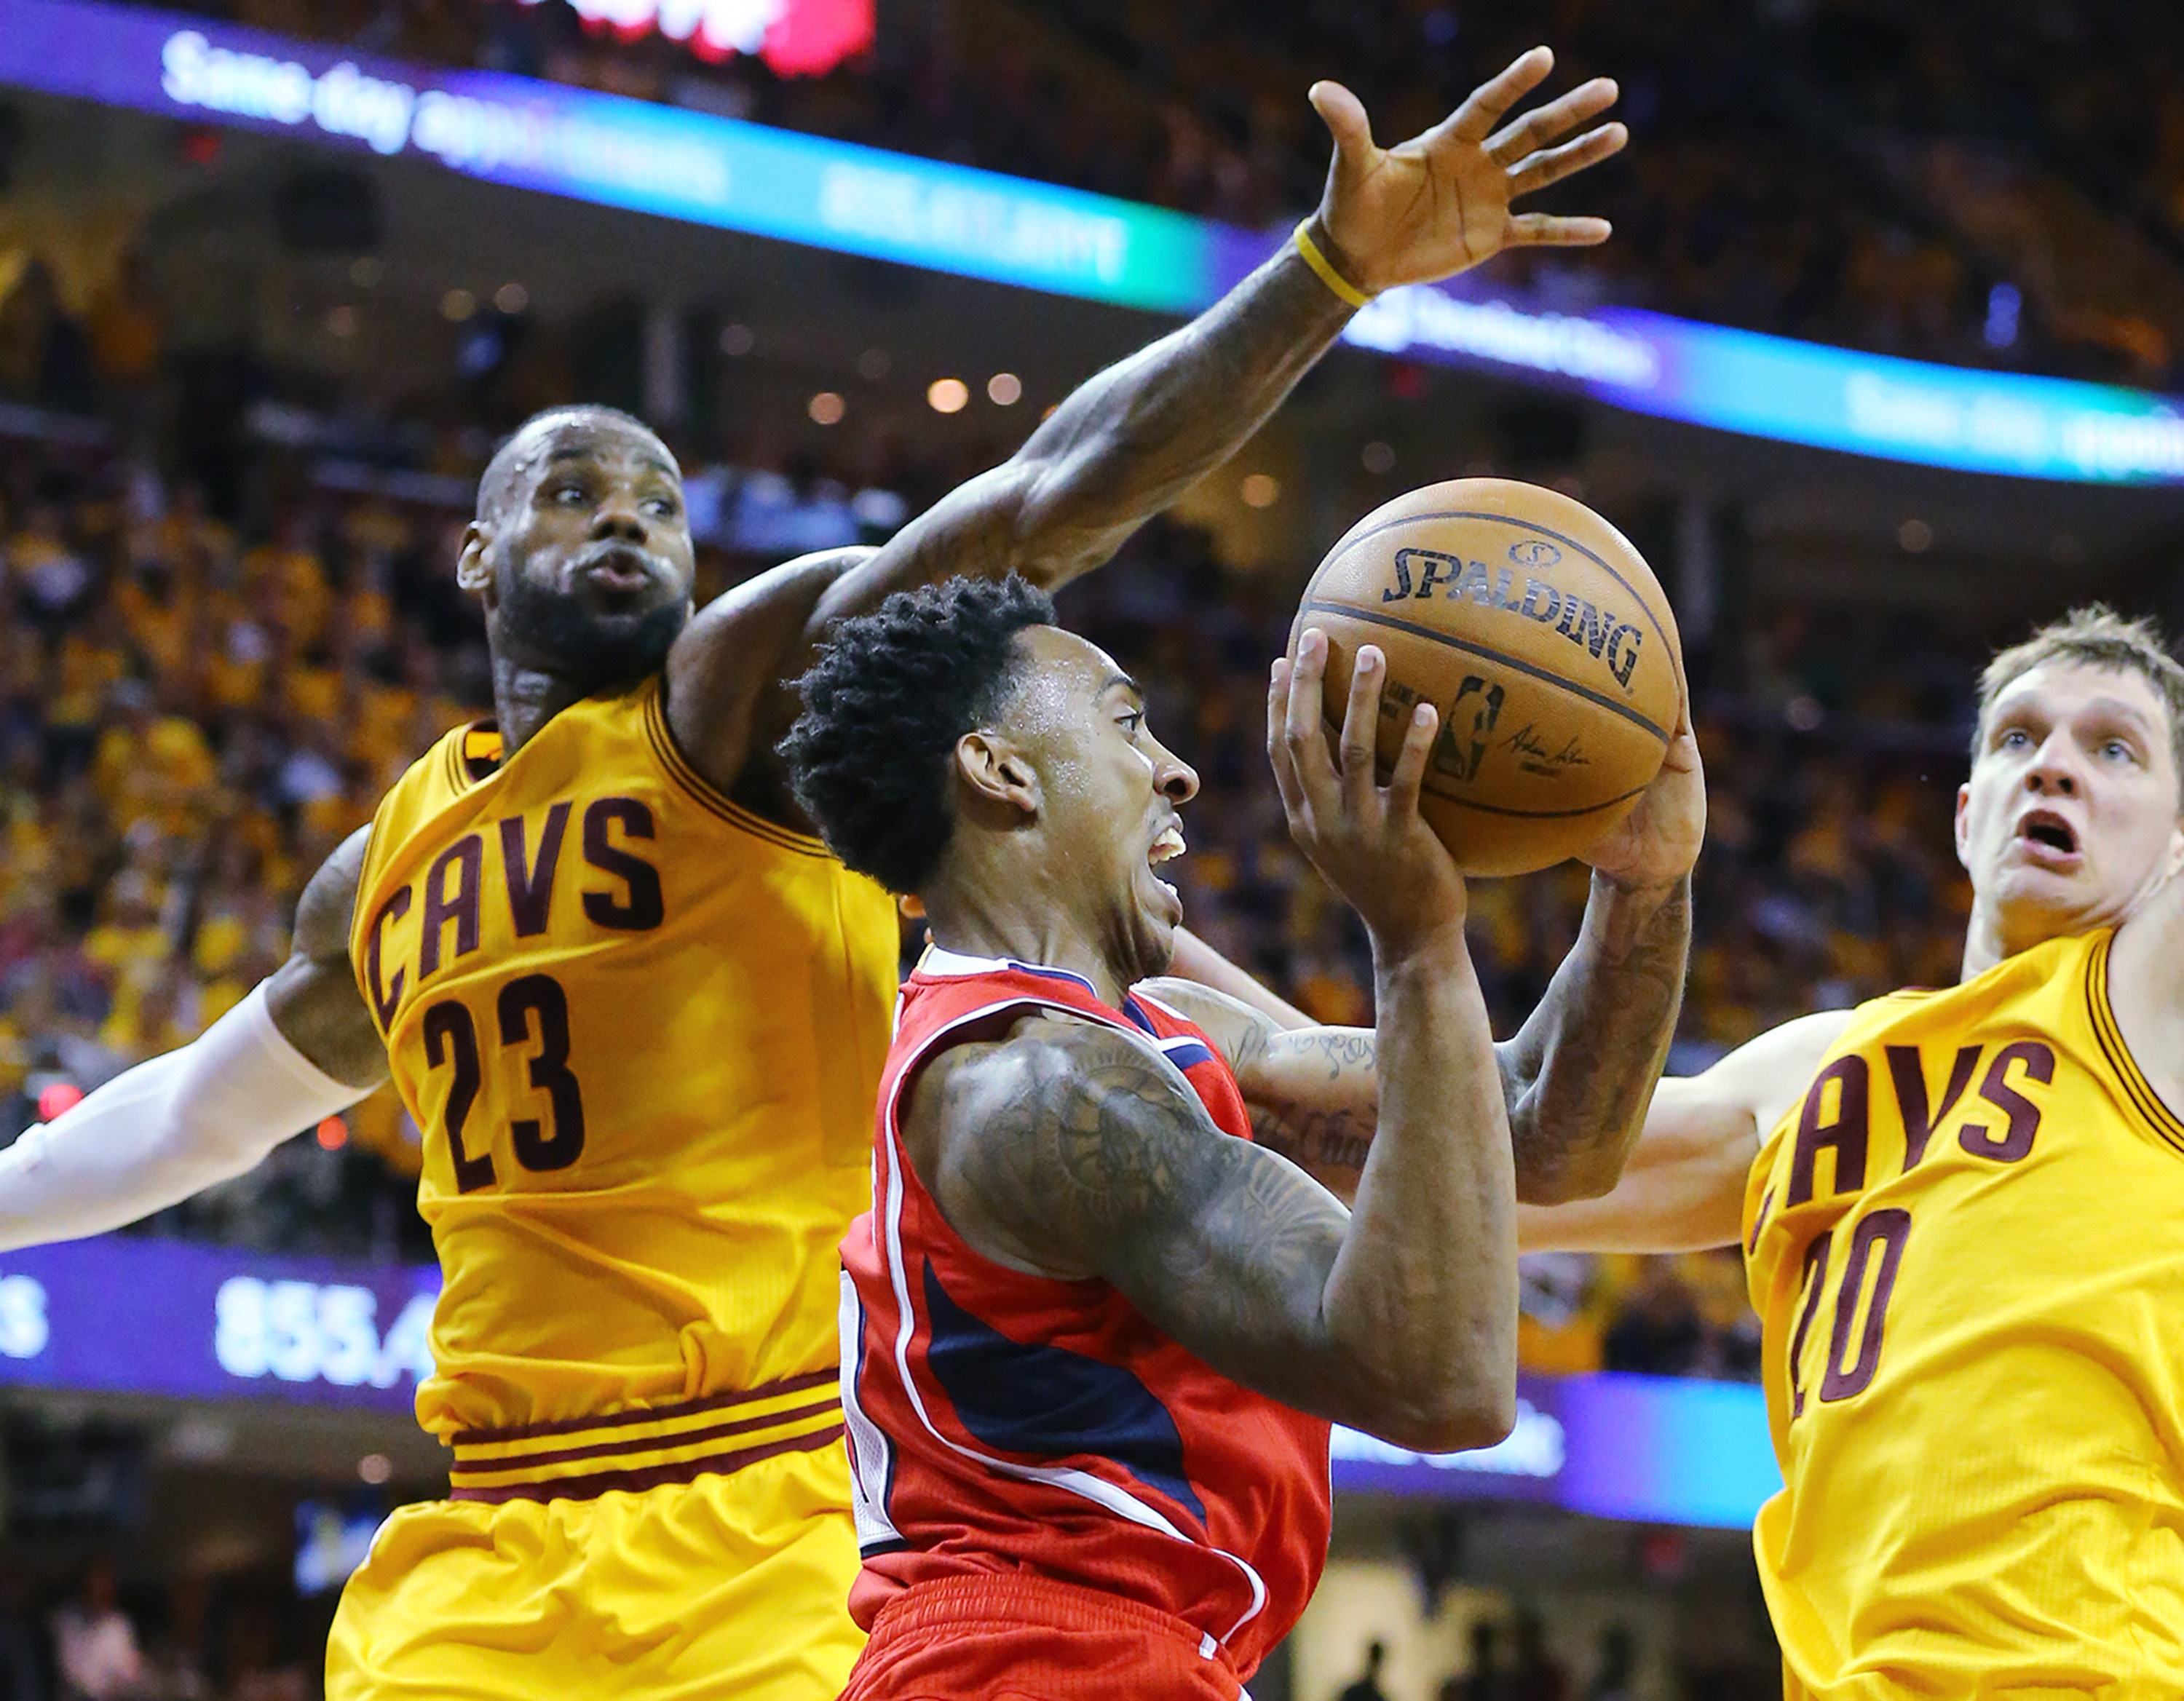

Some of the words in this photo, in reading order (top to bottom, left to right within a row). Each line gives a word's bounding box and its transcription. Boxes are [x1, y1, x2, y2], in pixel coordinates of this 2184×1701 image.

[1382, 547, 1642, 689] SPALDING
[367, 796, 665, 1035] CAVS
[422, 973, 585, 1194] 23
[1749, 1041, 2055, 1256] AVS
